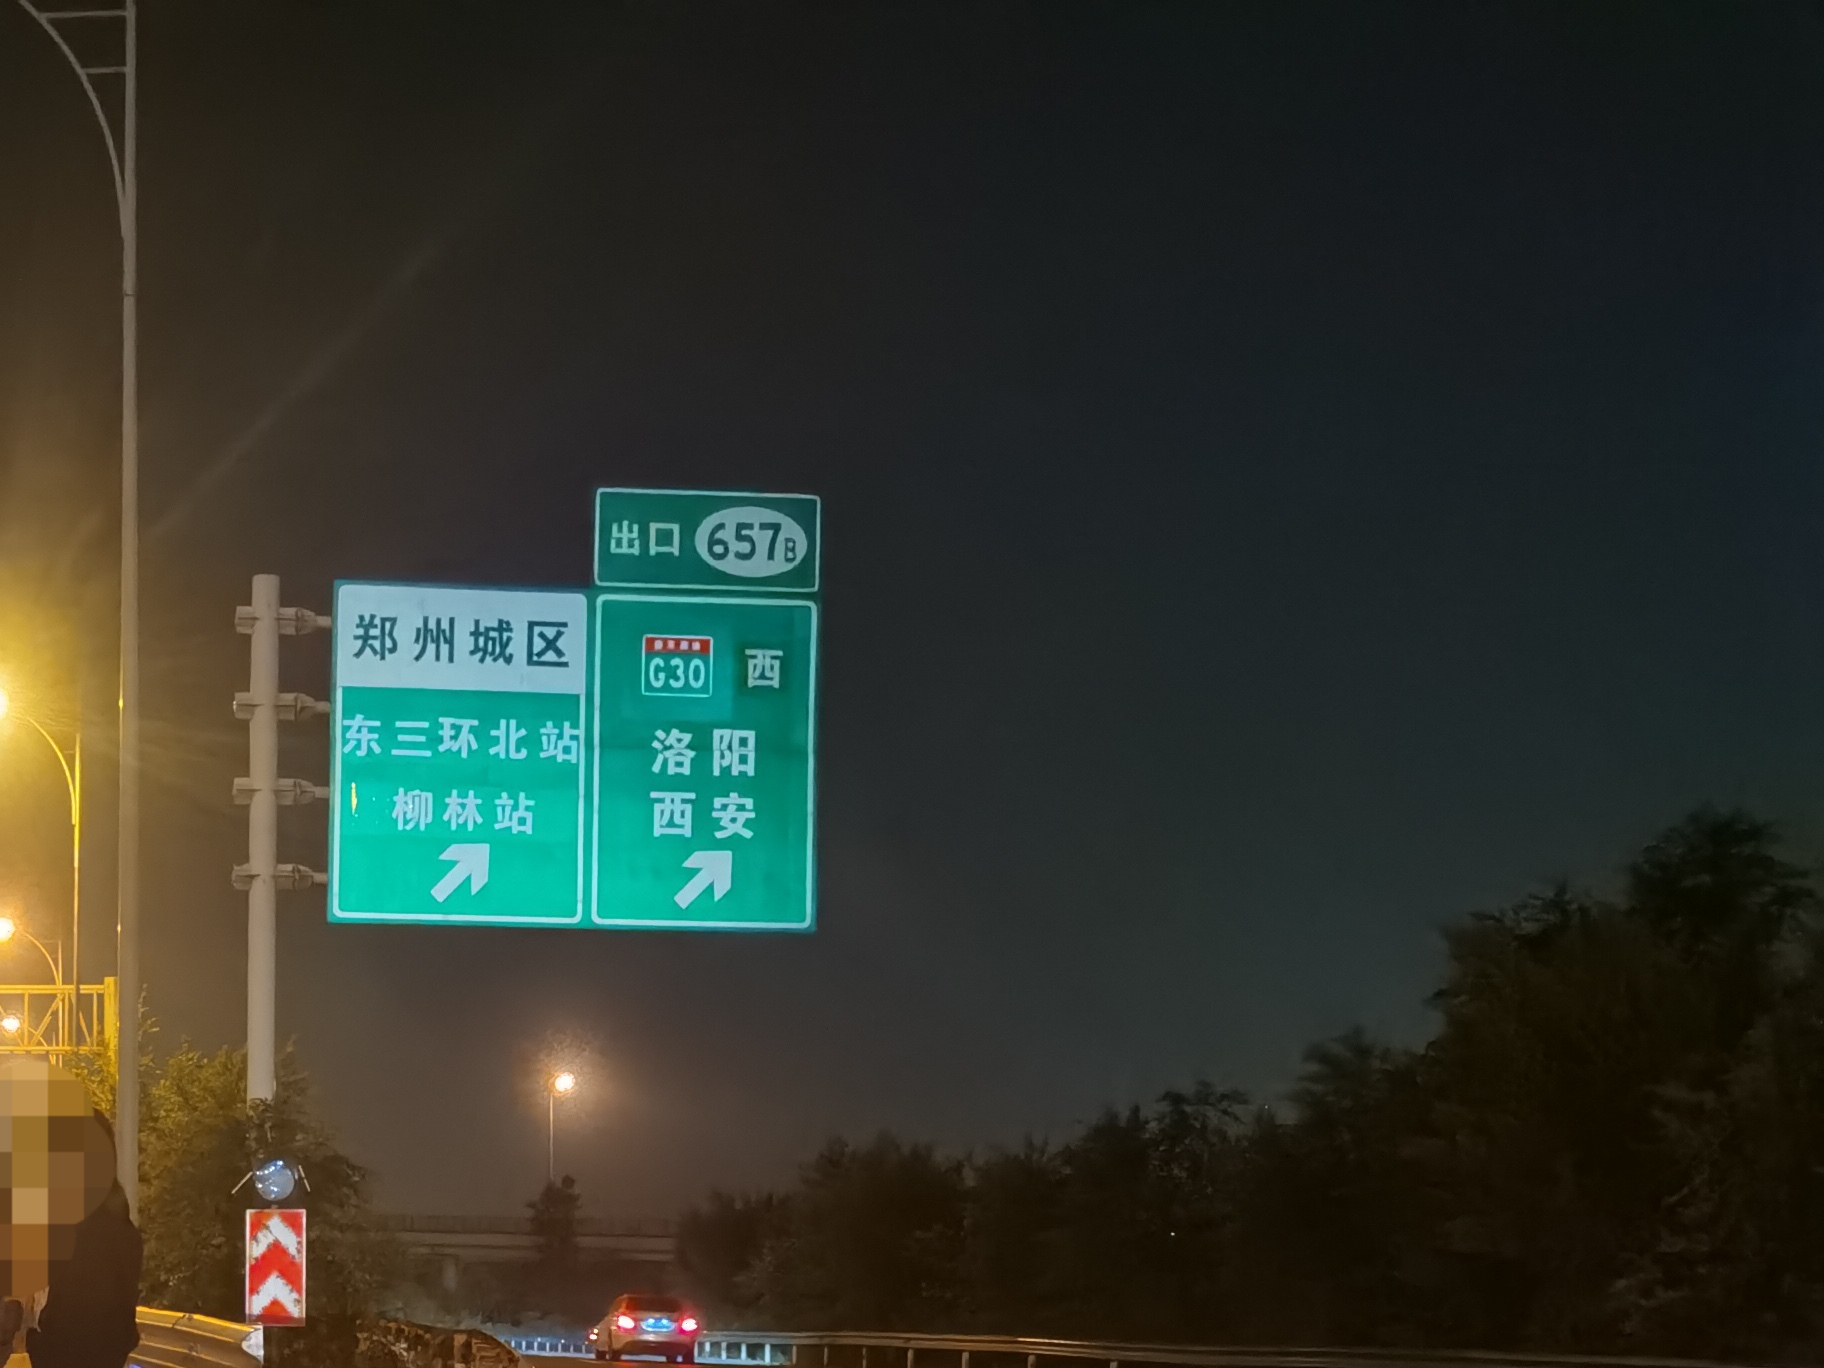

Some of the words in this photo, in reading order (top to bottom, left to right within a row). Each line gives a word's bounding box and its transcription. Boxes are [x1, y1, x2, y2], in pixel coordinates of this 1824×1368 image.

[610, 520, 680, 556] 出口
[707, 522, 797, 563] 657B
[352, 614, 570, 668] 郑州城区
[649, 657, 705, 688] G30
[744, 648, 784, 689] 西
[342, 714, 579, 763] 东三环北站
[651, 728, 757, 776] 洛阳
[392, 788, 535, 834] 柳林站
[650, 791, 756, 839] 西安
